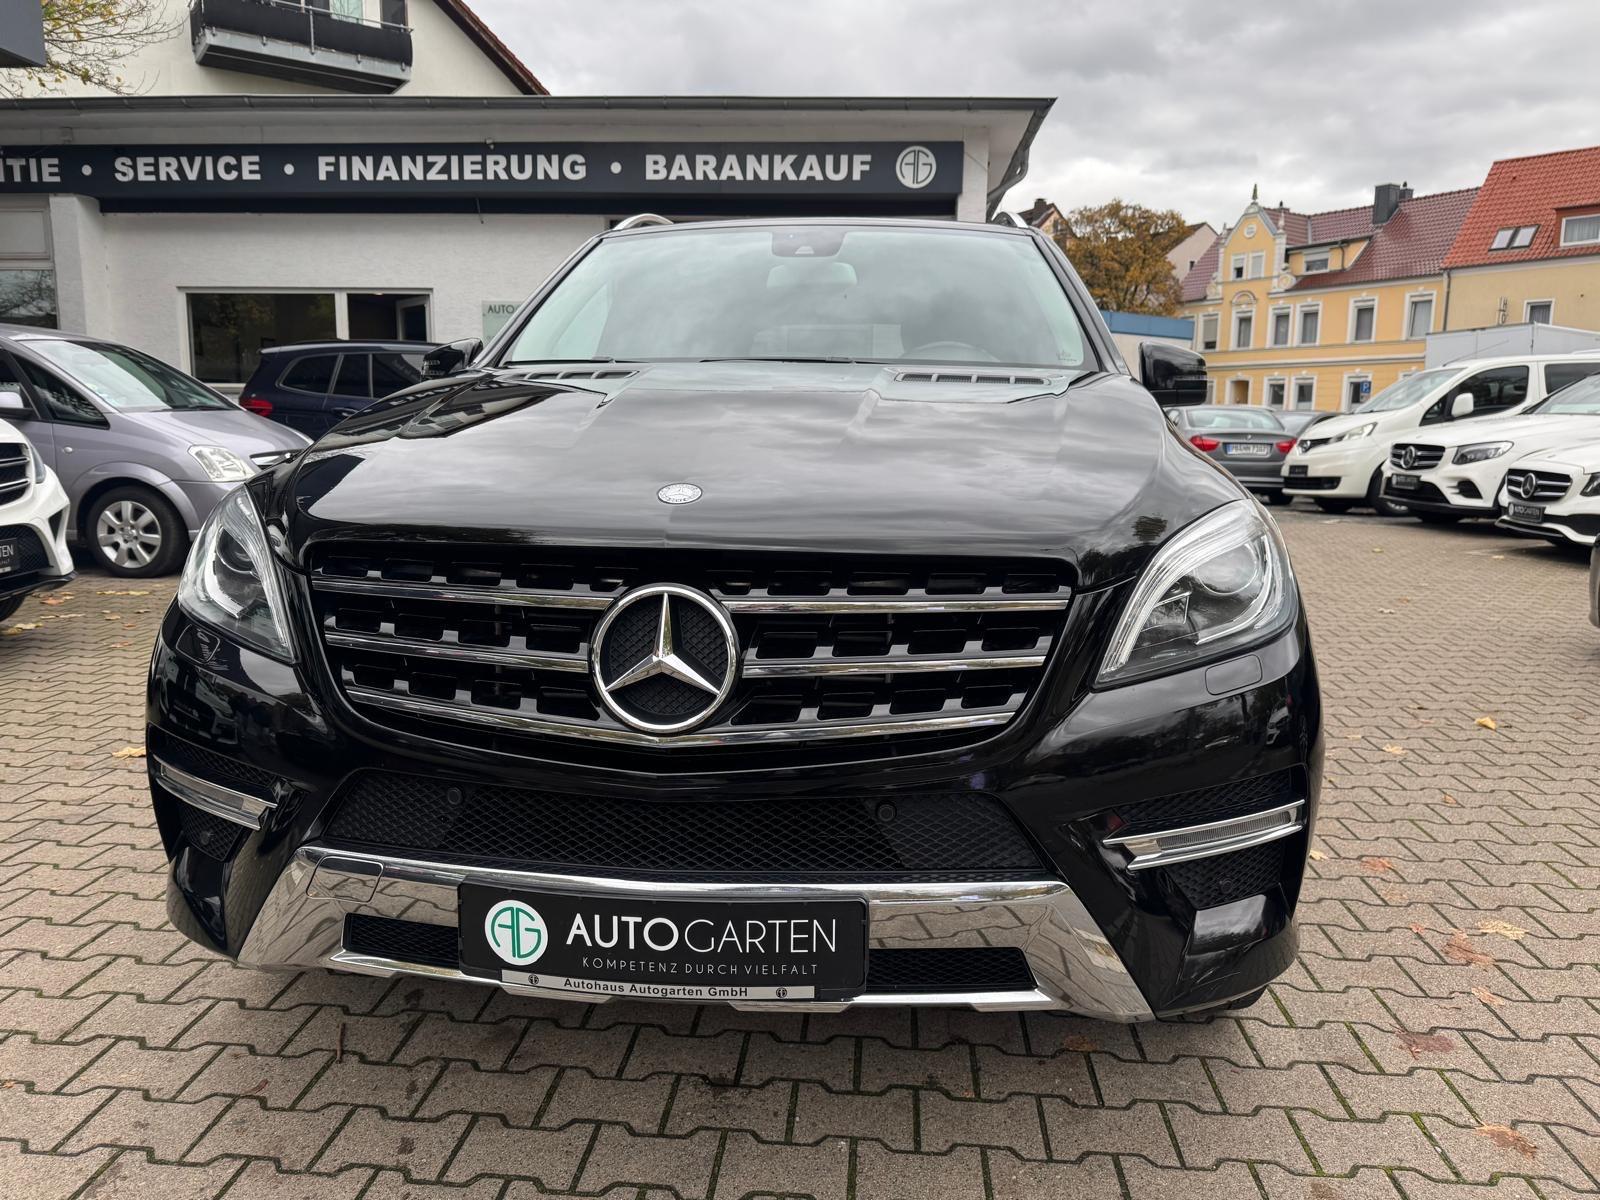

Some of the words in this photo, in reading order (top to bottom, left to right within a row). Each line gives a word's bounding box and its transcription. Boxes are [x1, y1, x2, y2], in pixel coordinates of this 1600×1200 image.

[114, 155, 261, 182] SERVICE
[317, 154, 587, 181] FINANZIERUNG
[645, 154, 871, 181] BARANKAUF
[566, 913, 837, 953] AUTOGARTEN
[582, 957, 678, 973] KOMPETENZ
[685, 963, 738, 975] DURCH
[744, 964, 818, 975] VIELFALT
[564, 978, 625, 993] Autohaus
[629, 984, 703, 998] Autogarten
[707, 987, 748, 998] GmbH
